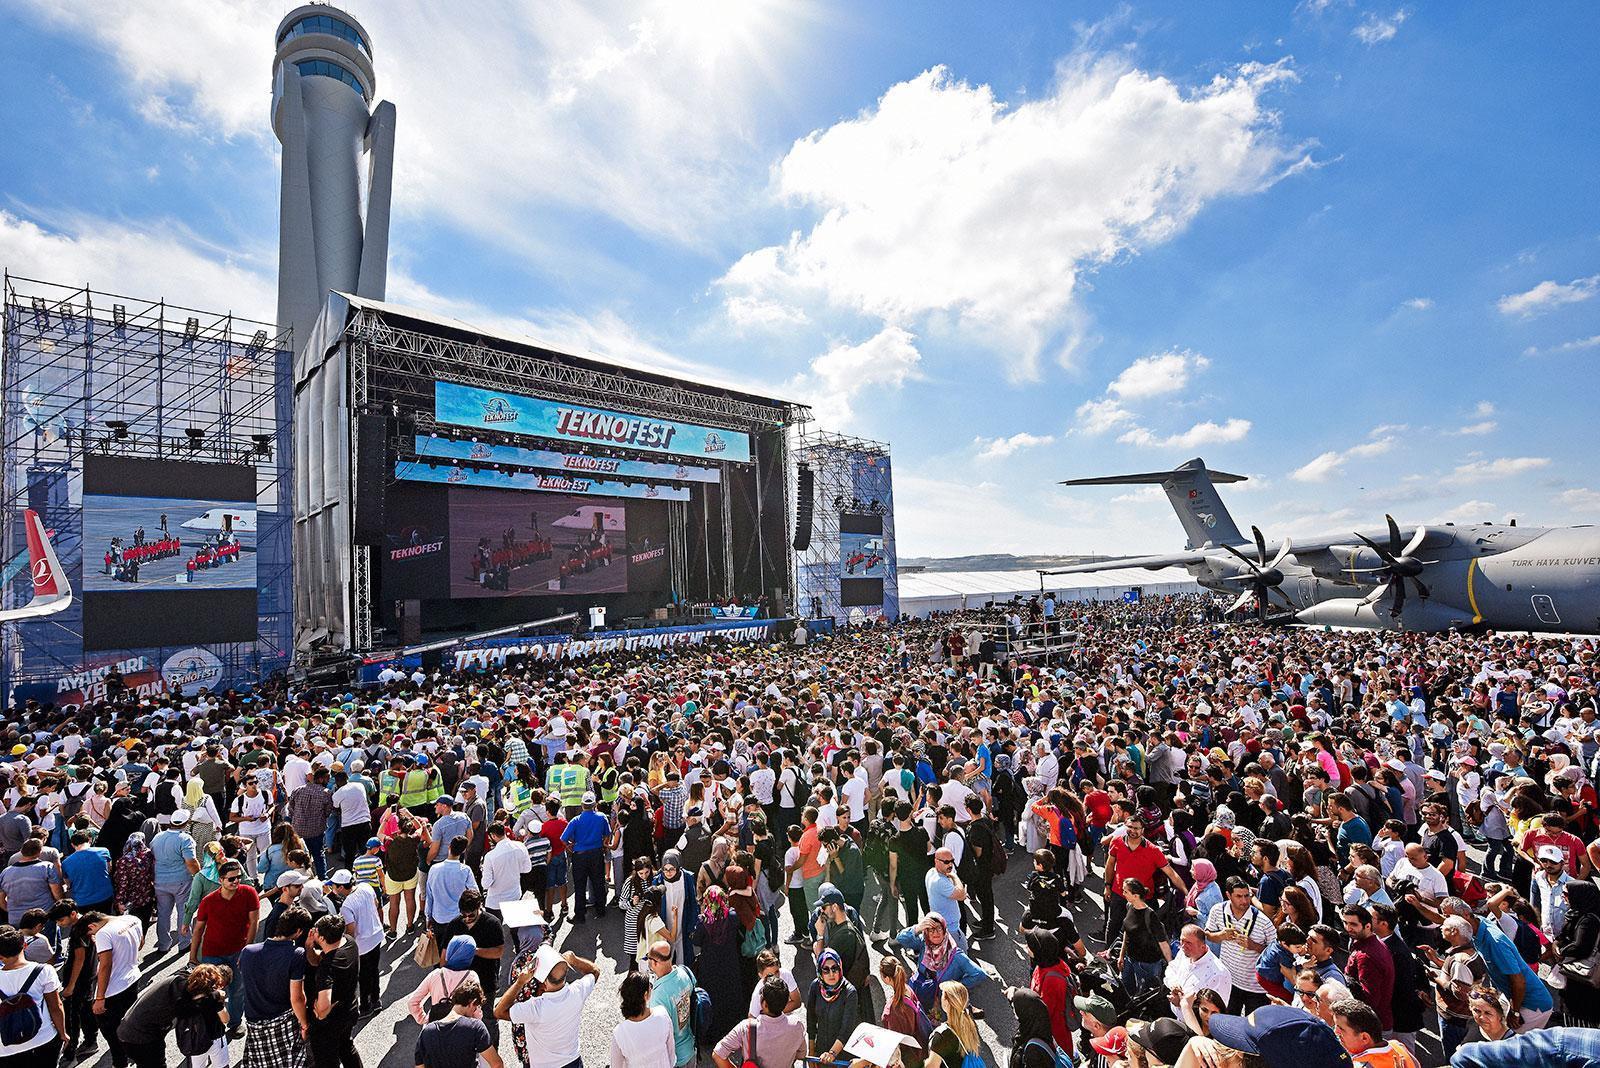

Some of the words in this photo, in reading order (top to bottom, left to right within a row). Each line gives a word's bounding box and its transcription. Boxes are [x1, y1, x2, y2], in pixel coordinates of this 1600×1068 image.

[557, 407, 676, 448] TEKNOFEST
[562, 454, 620, 472] TEKNOFEST
[537, 475, 591, 492] TEKNOFEST
[390, 541, 443, 560] TEKNOFEST
[631, 548, 665, 563] TEKNOFEST
